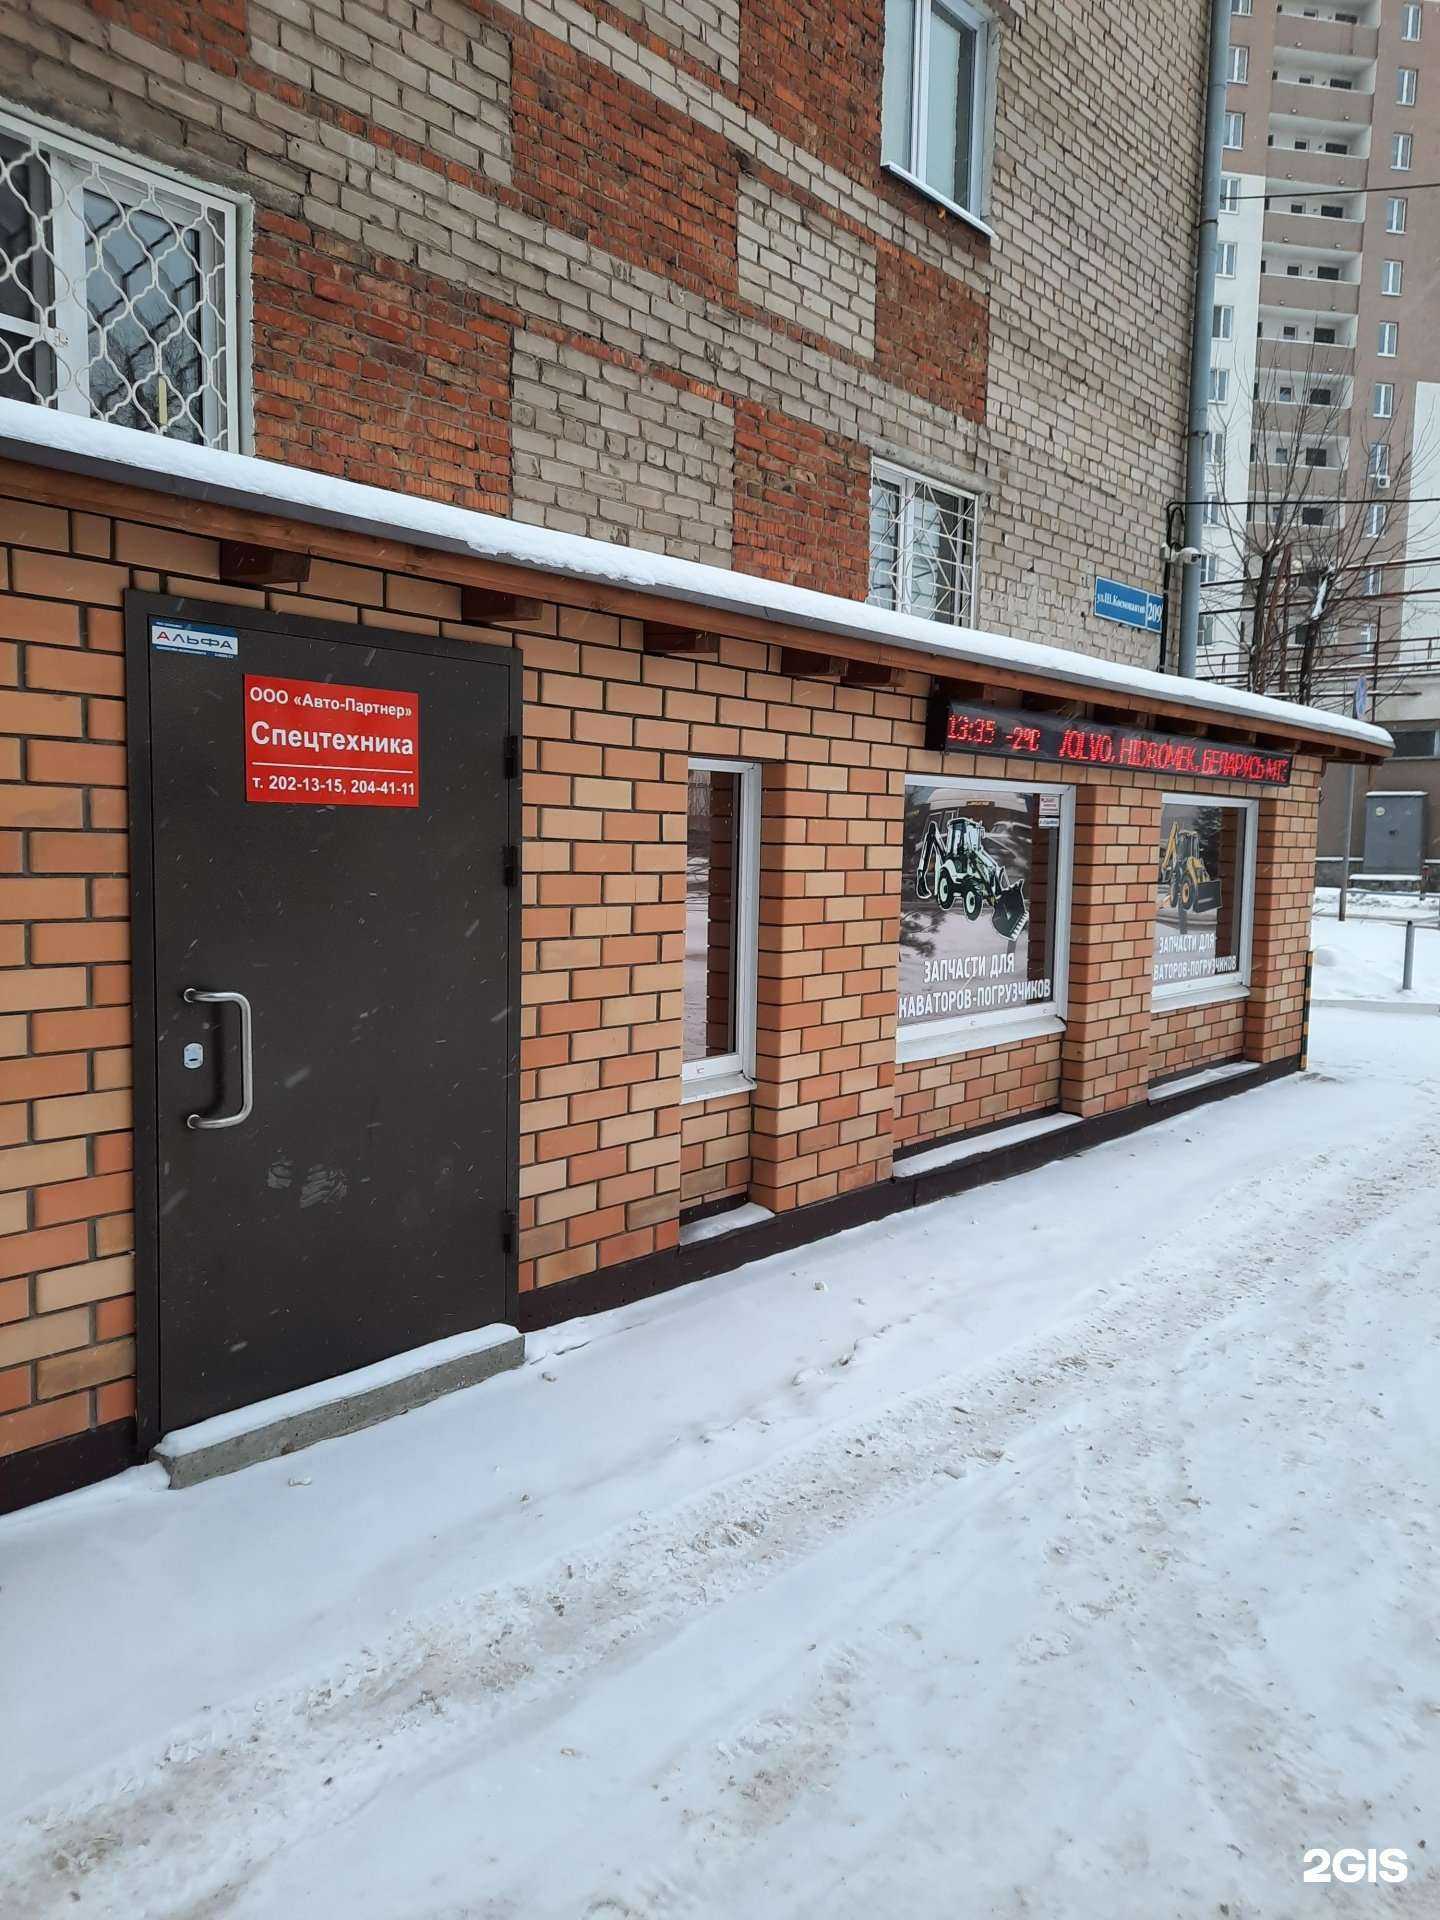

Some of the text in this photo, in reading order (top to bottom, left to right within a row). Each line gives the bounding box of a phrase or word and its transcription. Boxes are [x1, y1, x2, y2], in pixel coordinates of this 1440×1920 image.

[1147, 602, 1162, 623] 209
[156, 631, 233, 649] АЛЬФА
[250, 686, 412, 719] ООО «Авто-Партнер»
[251, 721, 414, 755] Спецтехника
[947, 714, 995, 743] 13:35
[252, 775, 415, 795] т. 202-13-15, 204-41-11
[1159, 931, 1215, 954] ЗАПЧАСТИ ДЛЯ
[924, 952, 1015, 983] ЗАПЧАСТИ ДЛЯ
